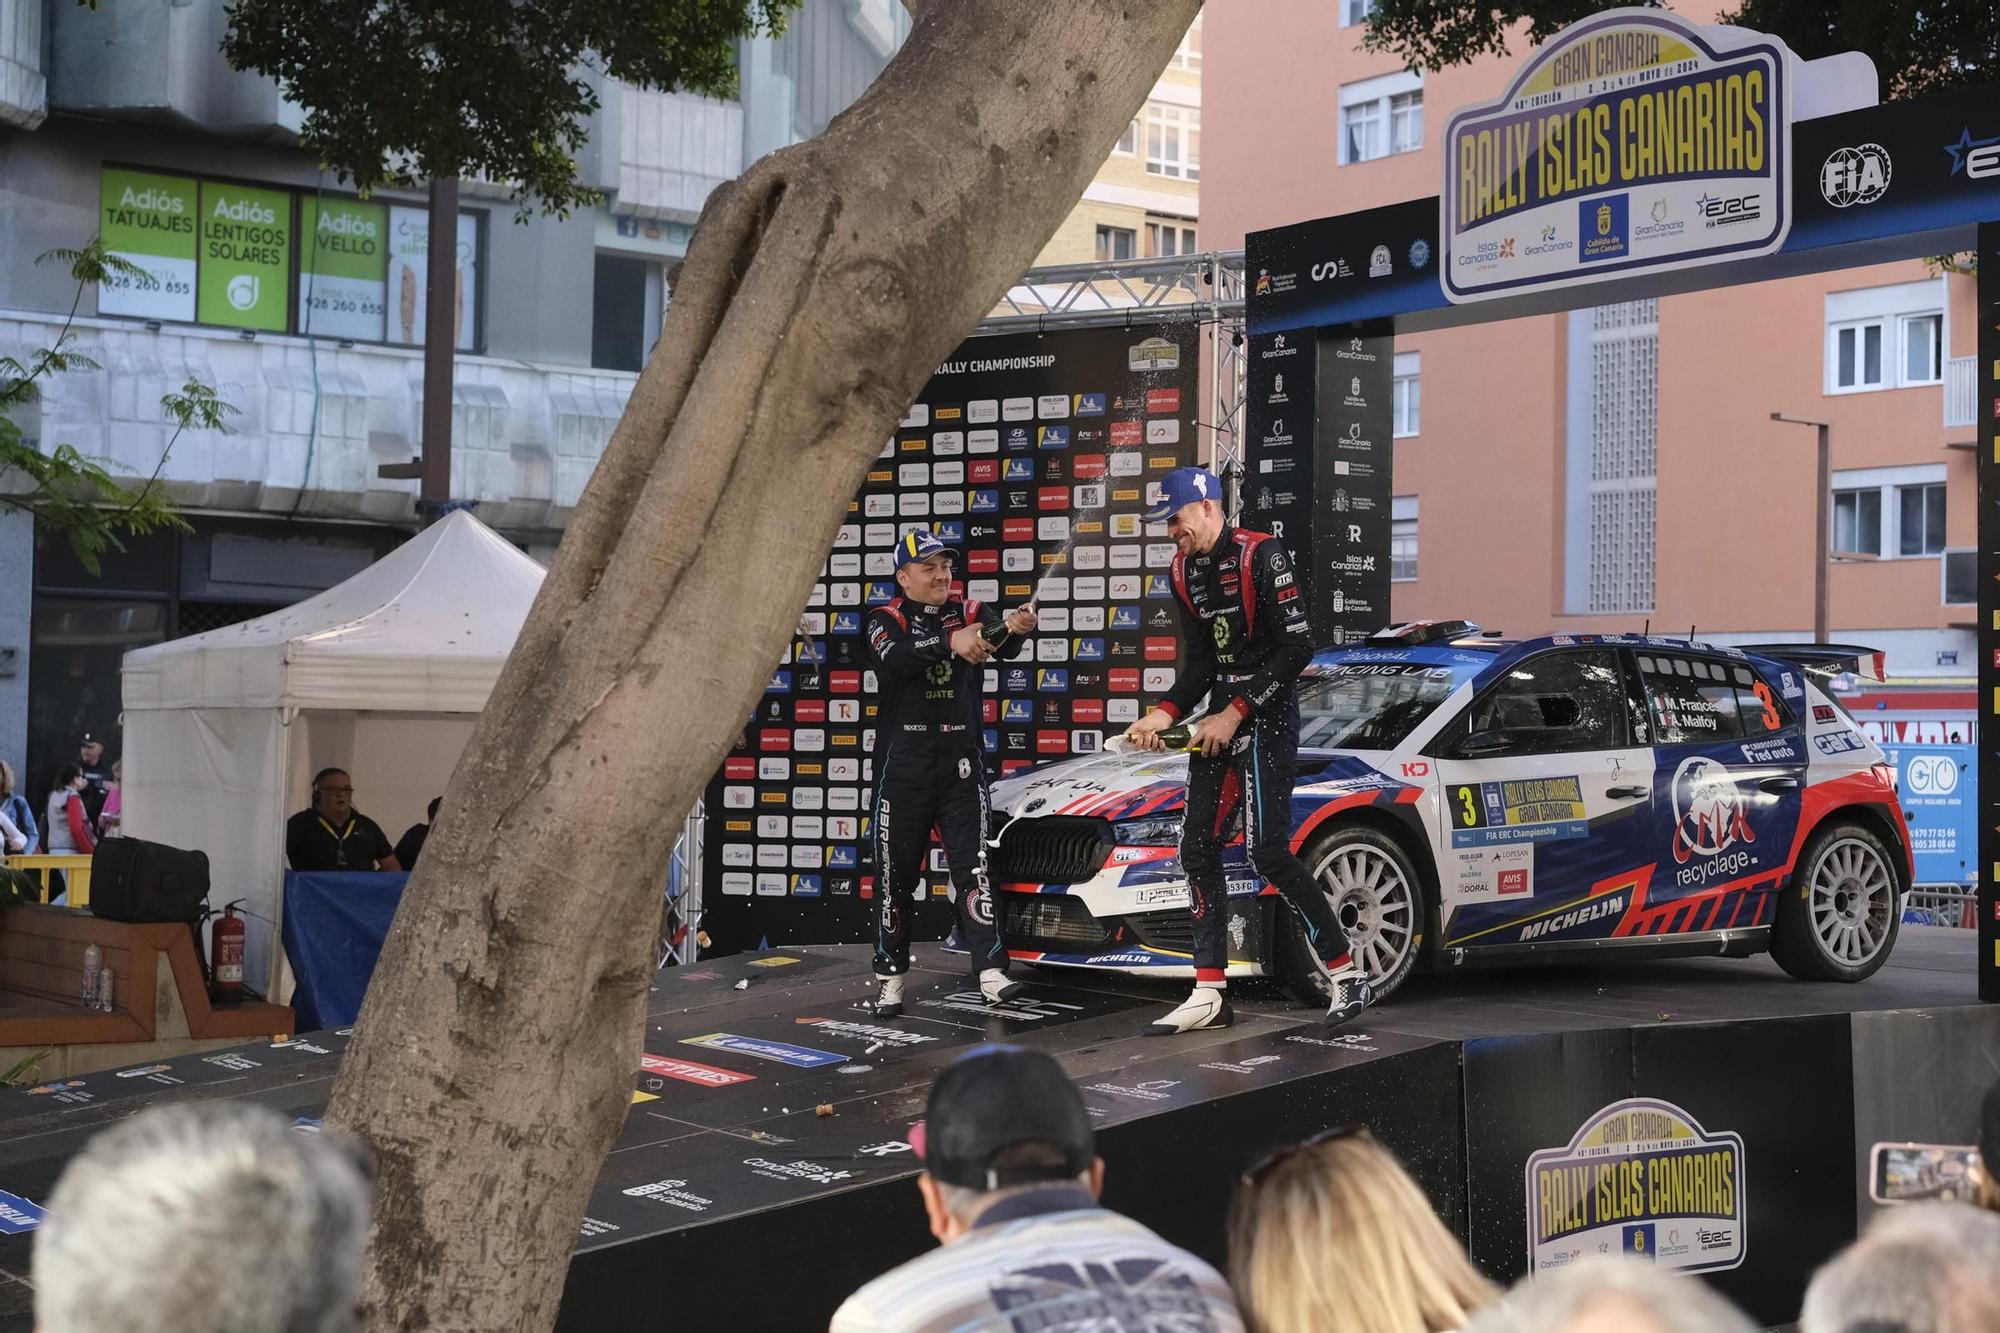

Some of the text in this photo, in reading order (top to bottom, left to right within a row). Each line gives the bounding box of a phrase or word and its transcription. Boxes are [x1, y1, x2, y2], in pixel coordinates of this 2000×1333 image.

[1553, 32, 1660, 88] GRAN CANARIA
[1639, 66, 1661, 82] MAYO
[1676, 60, 1699, 75] 2024
[1460, 69, 1764, 226] RALLY ISLAS CANARIAS
[120, 186, 184, 214] Adiós
[107, 207, 193, 234] TATUAJES
[214, 198, 275, 225] Adiós
[317, 211, 377, 237] Adiós
[205, 222, 285, 247] LENTIGOS
[209, 241, 280, 265] SOLARES
[316, 234, 376, 256] VELLO
[1477, 241, 1498, 254] Islas
[1458, 250, 1498, 266] Canarias
[135, 278, 160, 292] 260
[166, 281, 190, 295] 855
[332, 300, 357, 313] 260
[361, 302, 385, 315] 855
[934, 354, 1056, 376] RALLY CHAMPIONSHIP
[974, 465, 992, 473] AVIS
[1331, 560, 1362, 571] Canarias
[1346, 554, 1362, 563] Islas
[1319, 665, 1452, 679] RACING LAB
[1665, 699, 1679, 711] M.
[1753, 682, 1781, 731] 3
[1682, 714, 1717, 731] Malfoy
[1504, 778, 1580, 806] RALLY ISLAS CANARIAS
[1458, 786, 1477, 827] 3
[1519, 803, 1574, 823] GRAN CANARIA
[1486, 826, 1557, 840] FIA ERC Championship
[1914, 828, 1928, 838] 670
[1928, 828, 1937, 838] 77
[1946, 828, 1956, 838] 66
[1502, 849, 1528, 858] LOPESAN
[1914, 839, 1956, 849] 605 28 08 40
[1464, 883, 1489, 893] DORAL
[1503, 873, 1521, 884] AVIS
[1519, 896, 1623, 942] MICHELIN
[1086, 954, 1151, 965] MICHELIN
[1603, 1112, 1673, 1144] GRAN CANARIA
[1540, 1150, 1733, 1238] RALLY ISLAS CANARIAS
